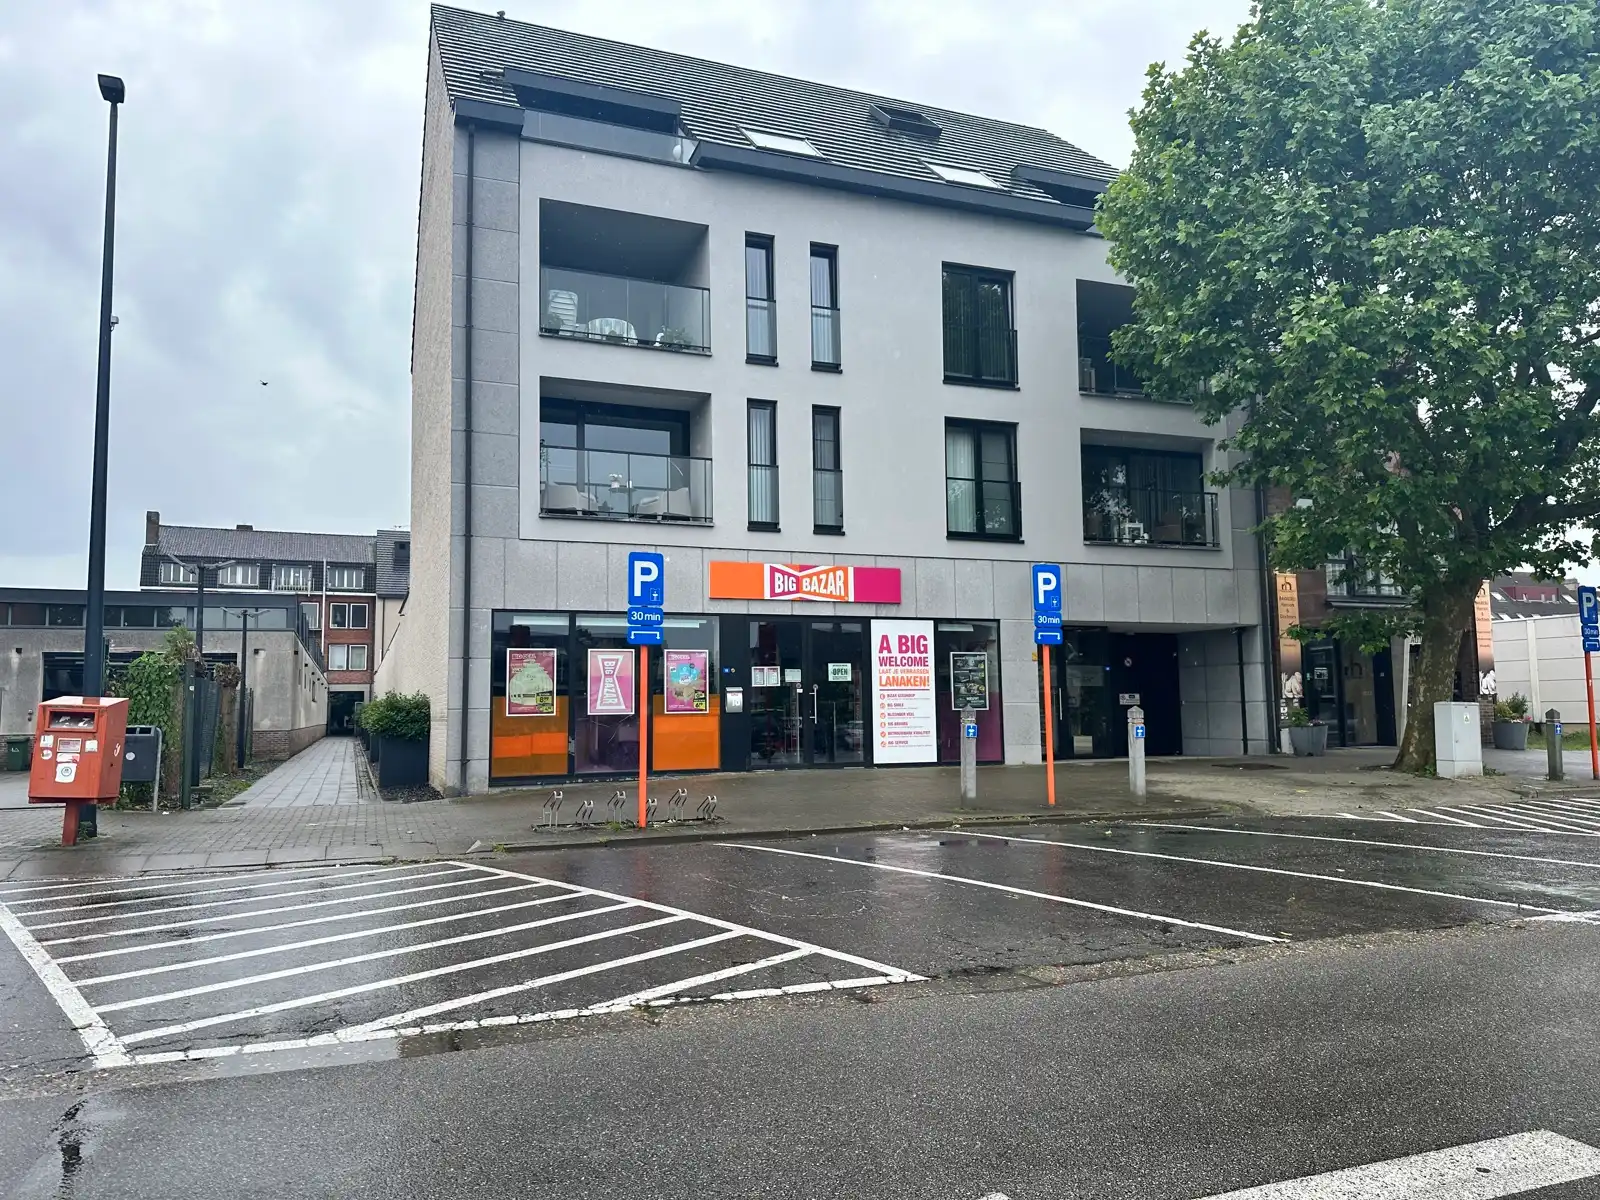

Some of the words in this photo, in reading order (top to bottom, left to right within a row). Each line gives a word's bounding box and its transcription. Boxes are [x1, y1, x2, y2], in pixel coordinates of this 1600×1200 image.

[634, 560, 659, 597] P
[774, 572, 797, 594] BIG
[802, 570, 845, 597] BAZAR
[1038, 572, 1057, 604] P
[1582, 592, 1594, 618] P
[631, 612, 644, 620] 30
[644, 612, 661, 620] min
[1038, 616, 1047, 624] 30
[1048, 616, 1060, 624] min
[878, 634, 892, 654] A
[898, 634, 928, 654] BIG
[604, 661, 616, 675] BIG
[878, 656, 929, 667] WELCOME
[602, 678, 618, 704] BAZAR
[879, 676, 930, 687] LANAKEN!
